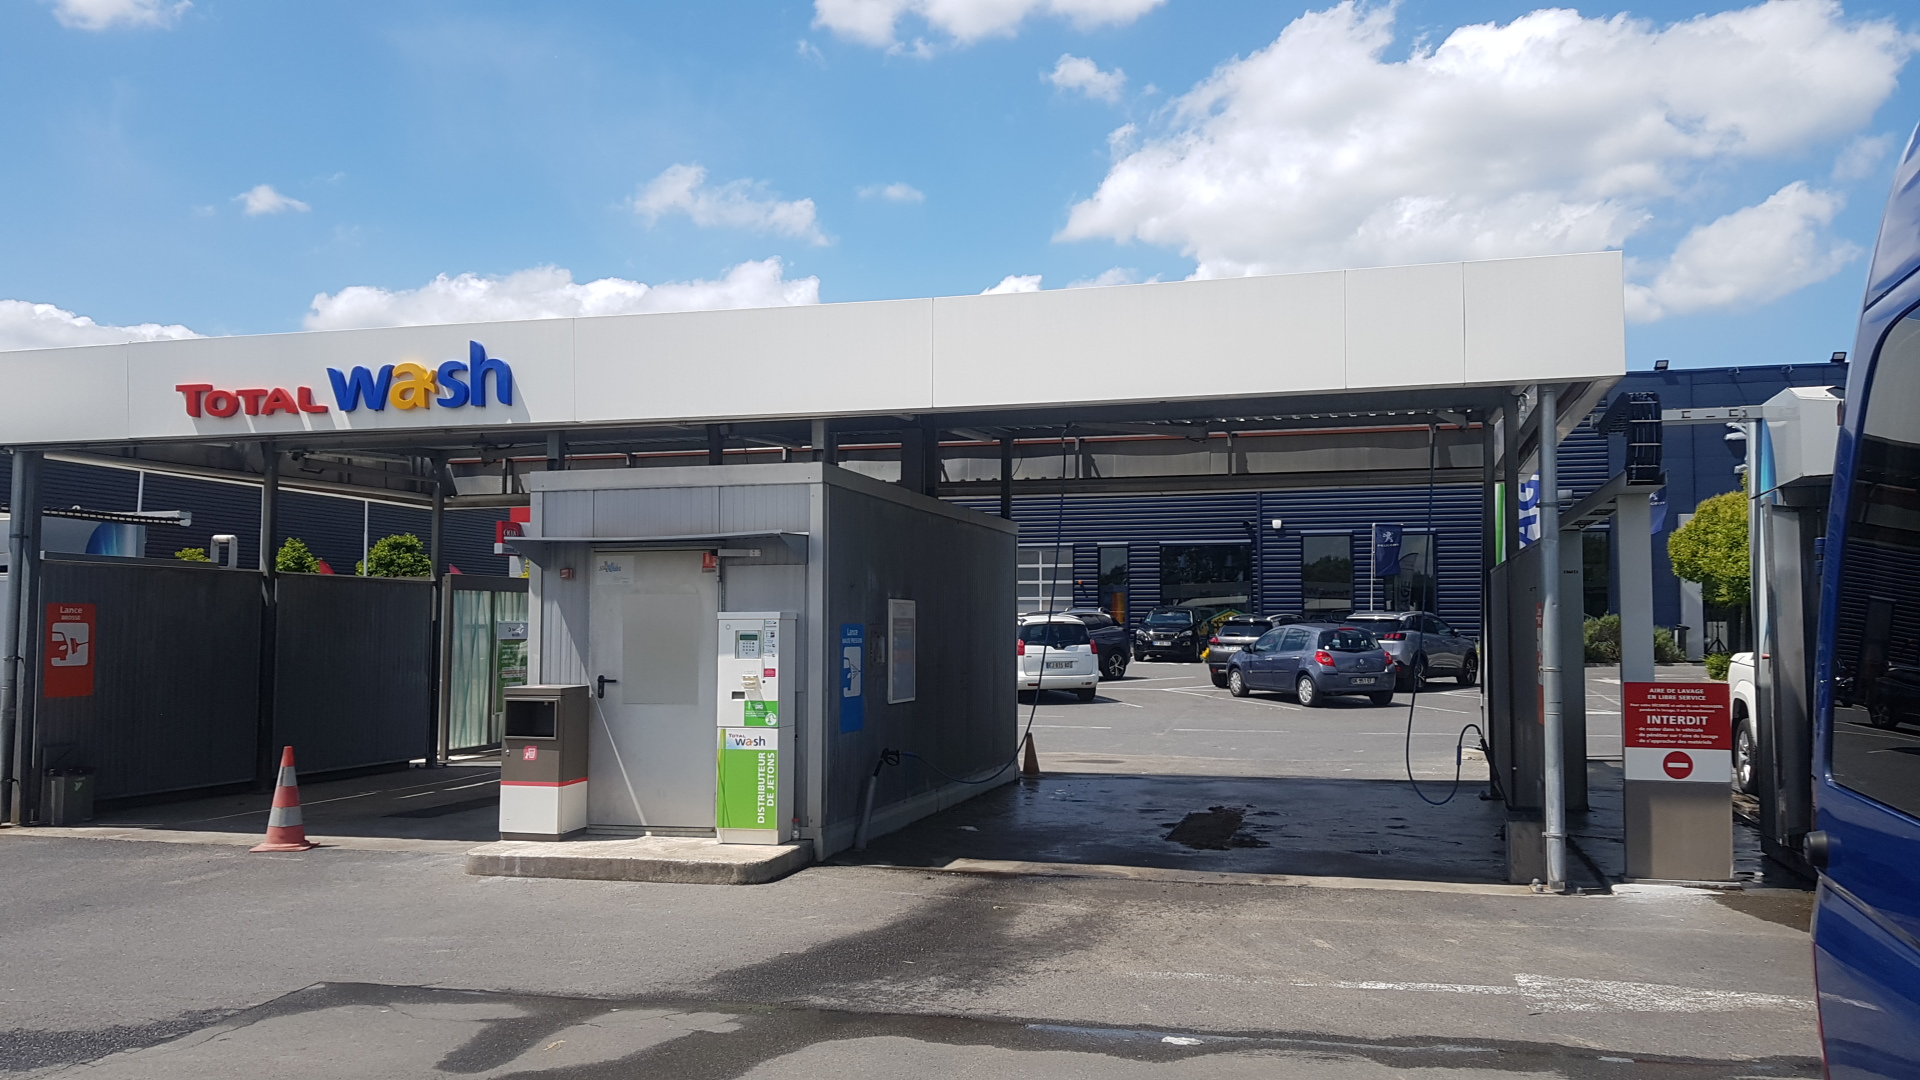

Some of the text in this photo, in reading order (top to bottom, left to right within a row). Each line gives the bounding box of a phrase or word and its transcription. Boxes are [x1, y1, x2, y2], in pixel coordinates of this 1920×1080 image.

[175, 340, 513, 418] TOTAL wash
[506, 529, 518, 537] KIA
[60, 606, 83, 614] Lance
[847, 627, 859, 636] Lance
[1646, 715, 1708, 726] INTERDIT
[735, 735, 767, 747] wash
[766, 752, 775, 807] DE JETONS
[757, 752, 766, 824] DISTRIBUTEUR
